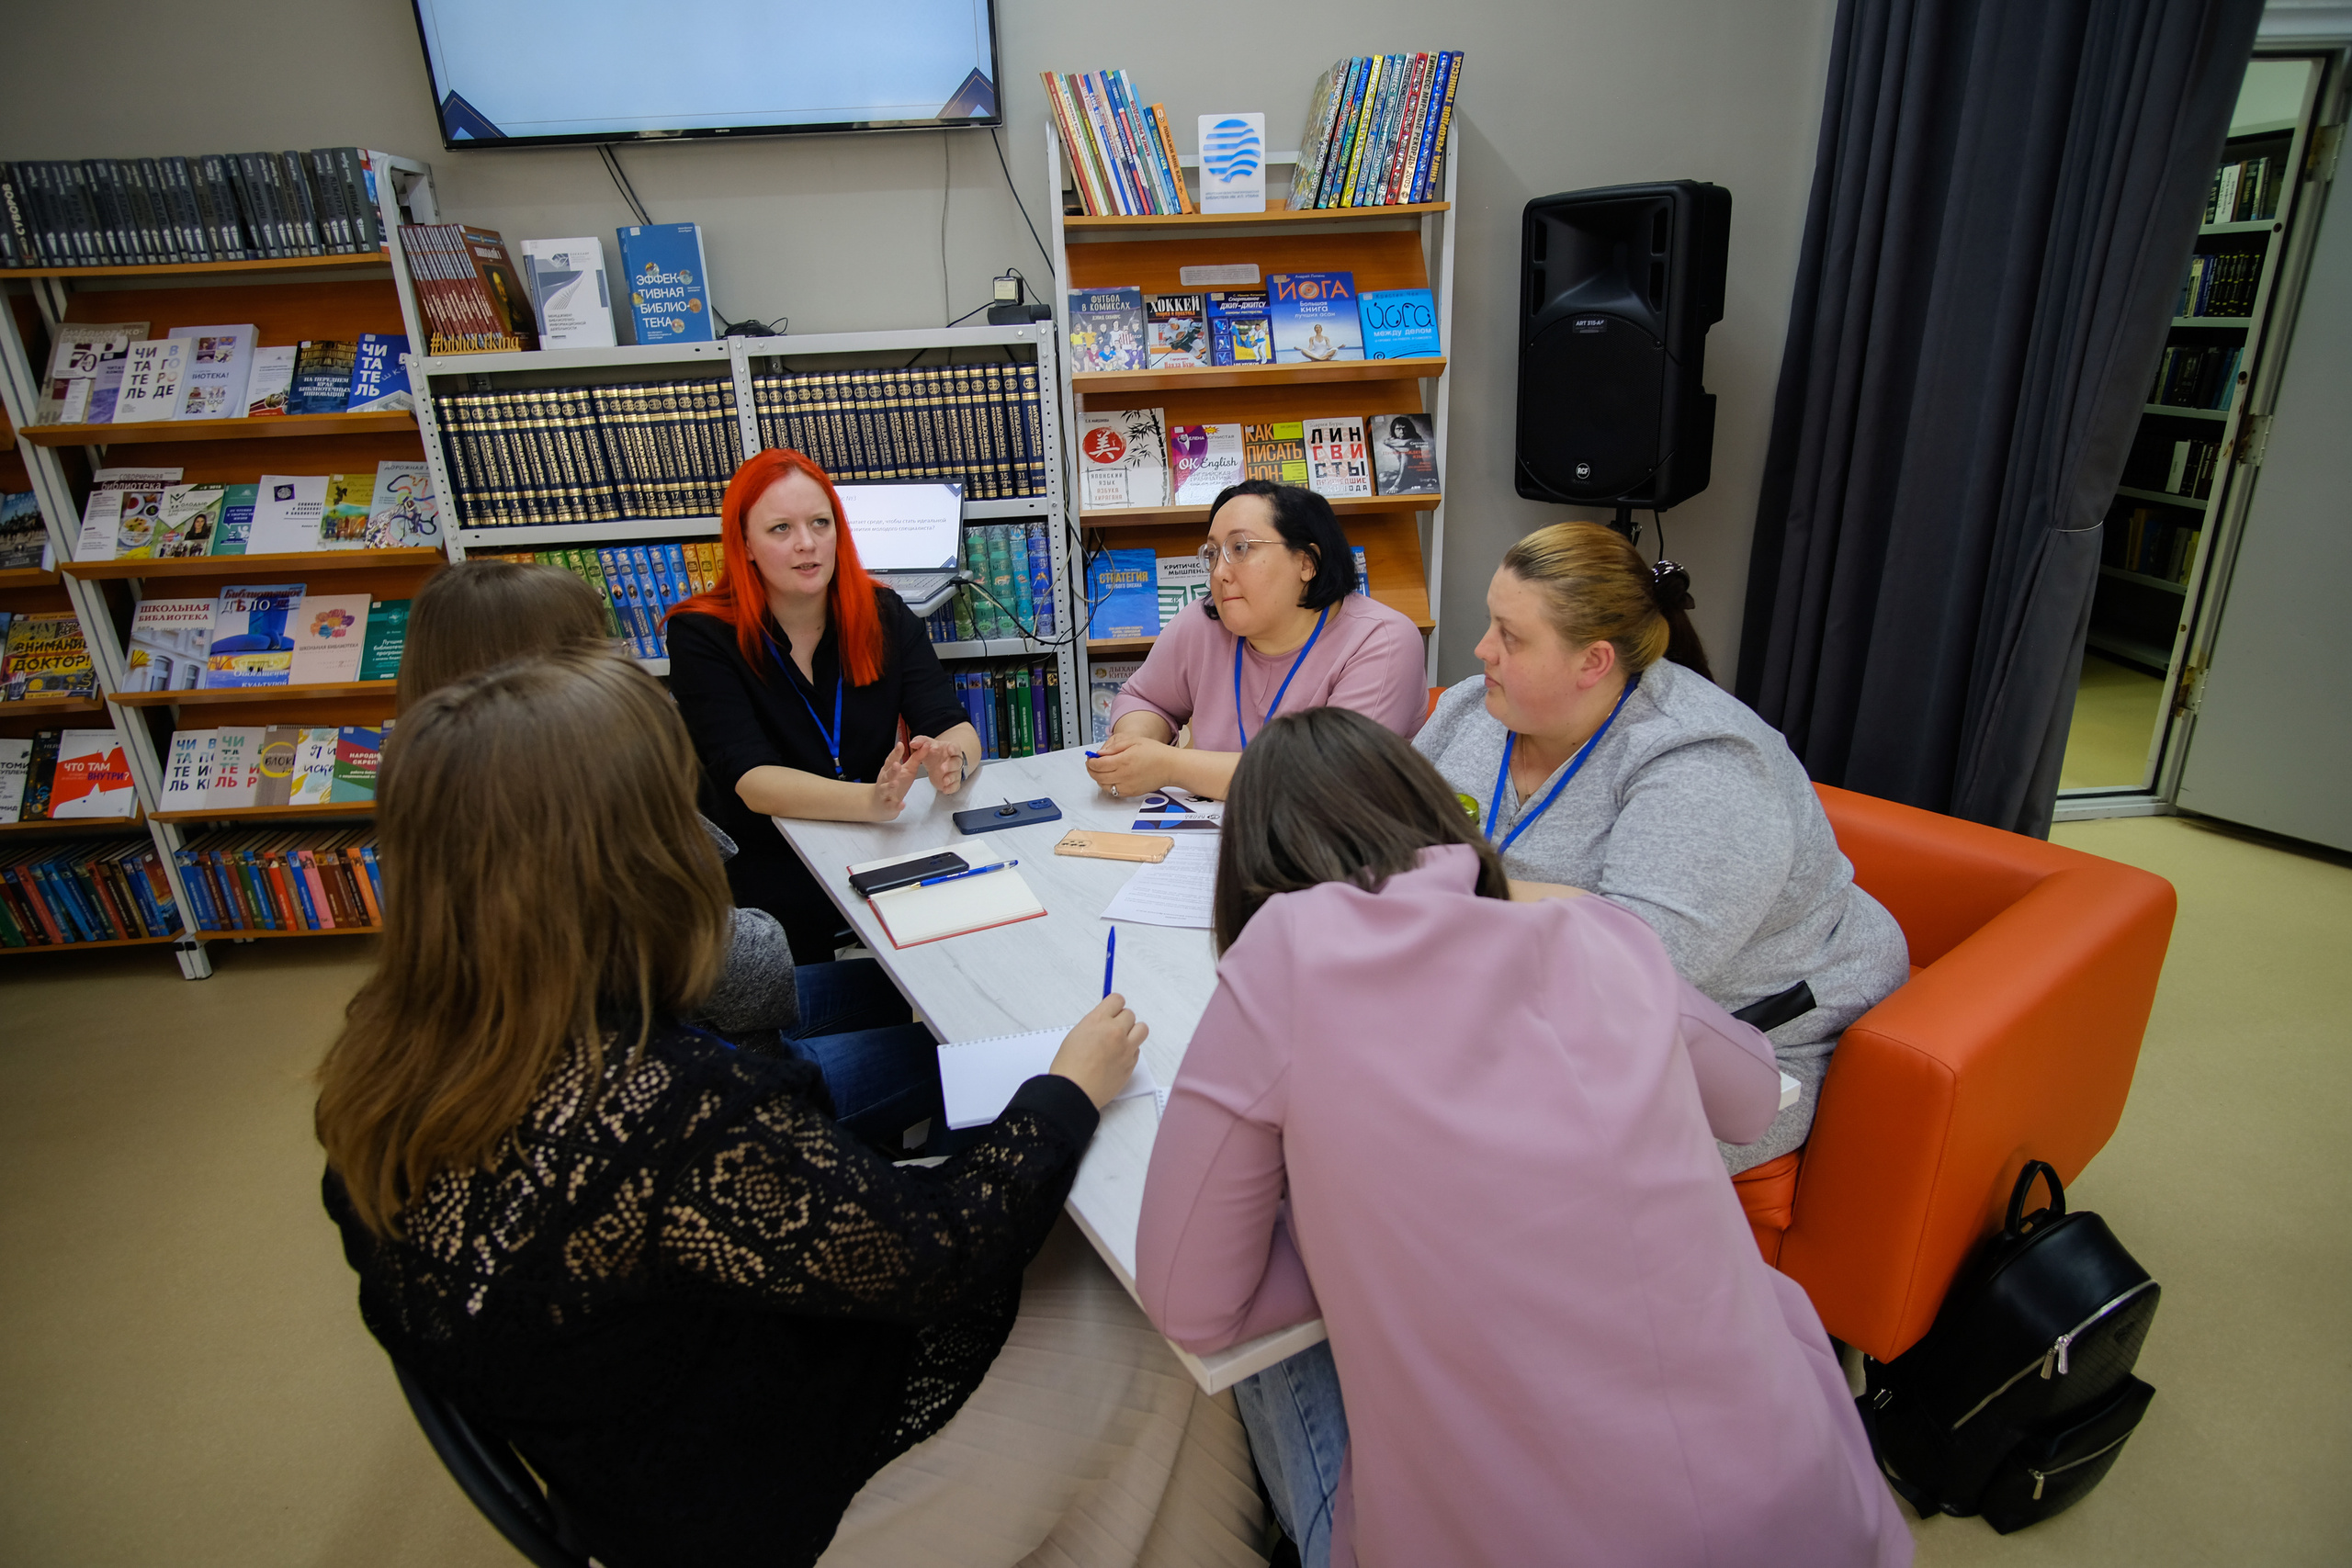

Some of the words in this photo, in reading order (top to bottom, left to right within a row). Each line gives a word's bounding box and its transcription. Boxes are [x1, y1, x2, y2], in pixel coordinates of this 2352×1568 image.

[1369, 60, 1381, 94] ГИННЕСС
[1379, 59, 1392, 93] ГИННЕСС
[1390, 60, 1402, 92] ГИННЕСС
[1401, 59, 1413, 95] ГИННЕСС
[1412, 59, 1425, 92] ГИННЕСС
[1423, 55, 1436, 89] ГИННЕСС
[1435, 55, 1446, 91] ГИННЕСС
[1331, 73, 1345, 104] ГИННЕСС
[1345, 71, 1358, 101] ГИННЕСС
[1356, 68, 1369, 97] ГИННЕСС
[1130, 100, 1144, 135] РЕКОРДОВ
[1349, 100, 1362, 133] МИРОВЫЕ
[1371, 95, 1384, 132] МИРОВЫЕ
[1382, 96, 1395, 133] МИРОВЫЕ
[1393, 95, 1406, 131] МИРОВЫЕ
[1403, 96, 1417, 131] МИРОВЫЕ
[1416, 91, 1429, 130] МИРОВЫЕ
[1427, 93, 1440, 130] МИРОВЫЕ
[1430, 155, 1441, 183] КНИГА
[1436, 106, 1450, 152] РЕКОРДОВ
[1445, 56, 1460, 102] ГИННЕССА
[1323, 106, 1337, 140] МИРОВЫЕ
[1336, 104, 1350, 138] МИРОВЫЕ
[1114, 136, 1125, 157] КНИГА
[1141, 136, 1150, 156] КНИГА
[1161, 126, 1174, 152] ПОКАЖИ
[1314, 141, 1328, 173] РЕКОРДЫ
[1328, 141, 1340, 173] РЕКОРДЫ
[1340, 135, 1353, 166] РЕКОРДЫ
[1363, 135, 1375, 168] РЕКОРДЫ
[1374, 135, 1385, 170] РЕКОРДЫ
[1408, 132, 1419, 168] РЕКОРДЫ
[1419, 133, 1430, 171] РЕКОРДЫ
[1310, 174, 1319, 188] 2021
[1323, 175, 1332, 190] 2019
[1337, 168, 1346, 183] 2018
[1404, 170, 1412, 187] 2005
[2, 183, 26, 236] СУВОРОВ
[636, 273, 680, 286] ЭФФЕК-
[639, 287, 684, 299] ТИВНАЯ
[1278, 277, 1349, 301] ЙОГА
[640, 301, 690, 314] БИБЛИО-
[1082, 304, 1088, 312] В
[1090, 301, 1130, 311] КОМИКСАХ
[1091, 294, 1120, 304] ФУТБОЛ
[1150, 296, 1200, 313] ХОККЕЙ
[1219, 301, 1266, 310] ДЖИУ-ДЖИТСУ
[642, 317, 673, 328] ТЕКА
[1374, 329, 1402, 337] между
[1405, 327, 1432, 335] делом
[136, 347, 157, 359] ЧИ
[169, 345, 179, 356] В
[362, 344, 388, 356] ЧИ
[134, 361, 151, 372] ТА
[161, 358, 180, 370] ГО
[362, 357, 383, 370] ТА
[131, 374, 148, 386] ТЕ
[156, 371, 178, 383] РО
[360, 370, 380, 383] ТЕ
[125, 388, 147, 400] ЛЬ
[153, 384, 175, 400] ДЕ
[355, 384, 380, 397] ЛЬ
[966, 409, 976, 460] ЭНЦИКЛОПЕДИЯ
[980, 408, 990, 459] ЭНЦИКЛОПЕДИЯ
[996, 407, 1006, 457] ЭНЦИКЛОПЕДИЯ
[1013, 406, 1023, 457] ЭНЦИКЛОПЕДИЯ
[1032, 405, 1043, 456] ЭНЦИКЛОПЕДИЯ
[1245, 423, 1274, 443] КАК
[1310, 426, 1362, 445] ЛИН
[1090, 432, 1121, 459] 美
[1247, 443, 1303, 463] ПИСАТЬ
[1312, 444, 1364, 461] ГВИ
[1179, 457, 1200, 470] OK
[1200, 457, 1238, 471] English
[1315, 461, 1369, 479] СТЫ,
[119, 472, 164, 480] современная
[1000, 472, 1009, 480] 35
[101, 481, 162, 491] библиотека
[684, 491, 693, 499] 18
[712, 490, 720, 498] 20
[528, 499, 534, 507] 6
[1099, 571, 1148, 585] СТРАТЕГИЯ
[140, 604, 209, 613] ШКОЛЬНАЯ
[139, 614, 209, 622] БИБЛИОТЕКА
[13, 655, 90, 672] ДОКТОР!
[176, 739, 197, 750] ЧИ
[221, 736, 244, 747] ЧИ
[63, 762, 85, 772] ЧТО
[87, 762, 110, 772] ТАМ
[175, 752, 192, 764] ТА
[87, 772, 130, 781] ВНУТРИ?
[174, 766, 190, 777] ТЕ
[220, 763, 238, 774] ТЕ
[169, 781, 189, 792] ЛЬ
[215, 776, 238, 787] ЛЬ
[246, 777, 257, 787] Р
